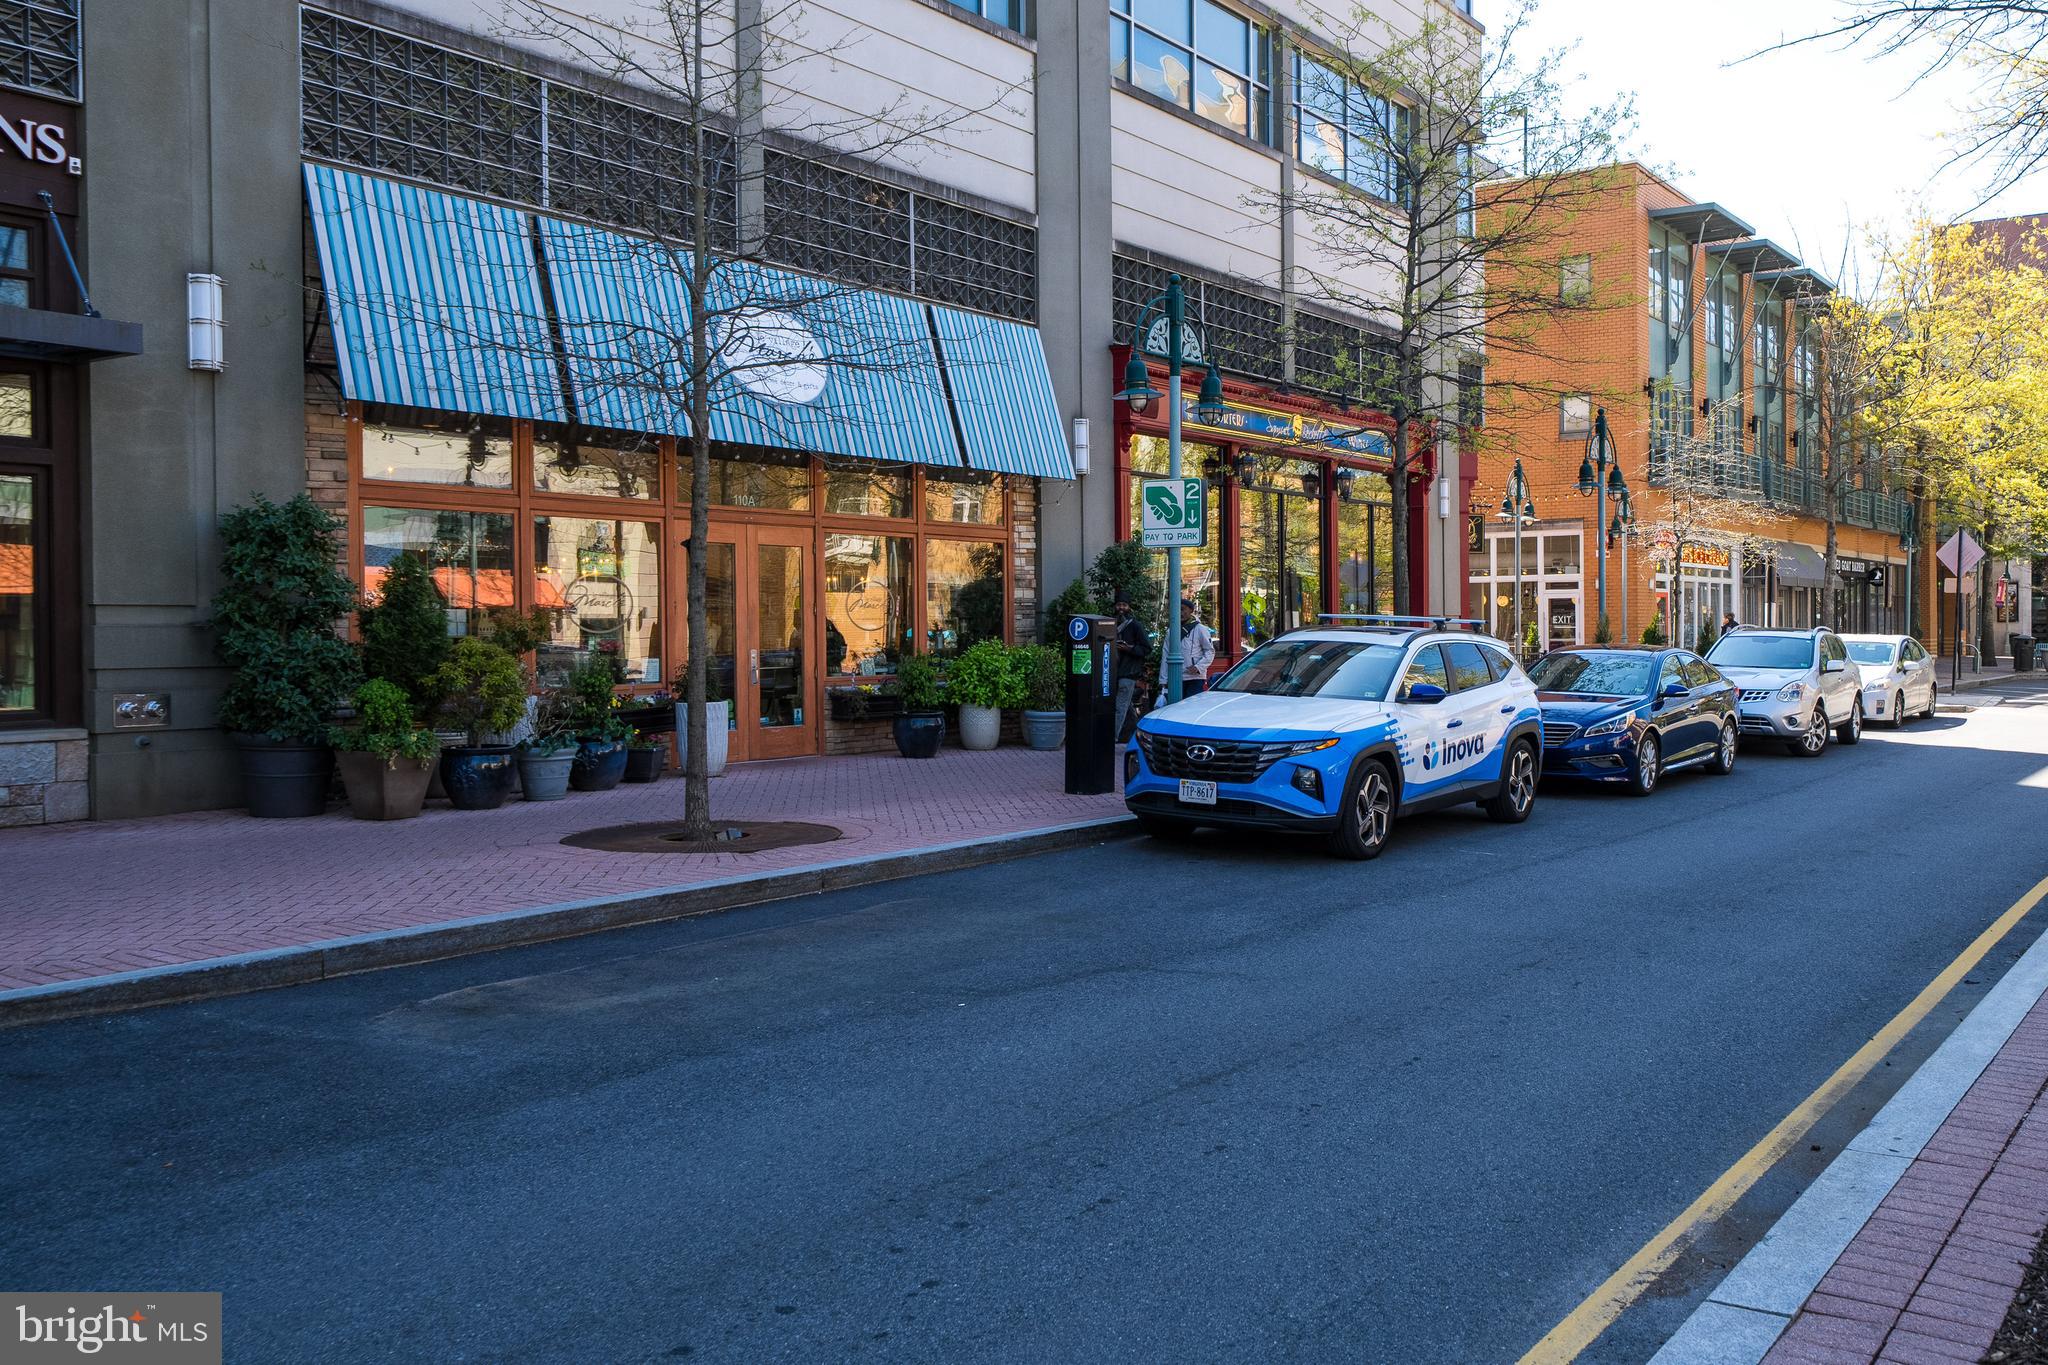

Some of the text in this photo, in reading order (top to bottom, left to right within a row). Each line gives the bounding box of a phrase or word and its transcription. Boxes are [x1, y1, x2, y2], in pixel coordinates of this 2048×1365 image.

[1186, 483, 1199, 499] 2
[734, 495, 755, 506] 110A
[1145, 533, 1159, 541] PAY
[1177, 532, 1198, 540] PARK
[1552, 615, 1572, 624] EXIT
[1074, 621, 1084, 637] P
